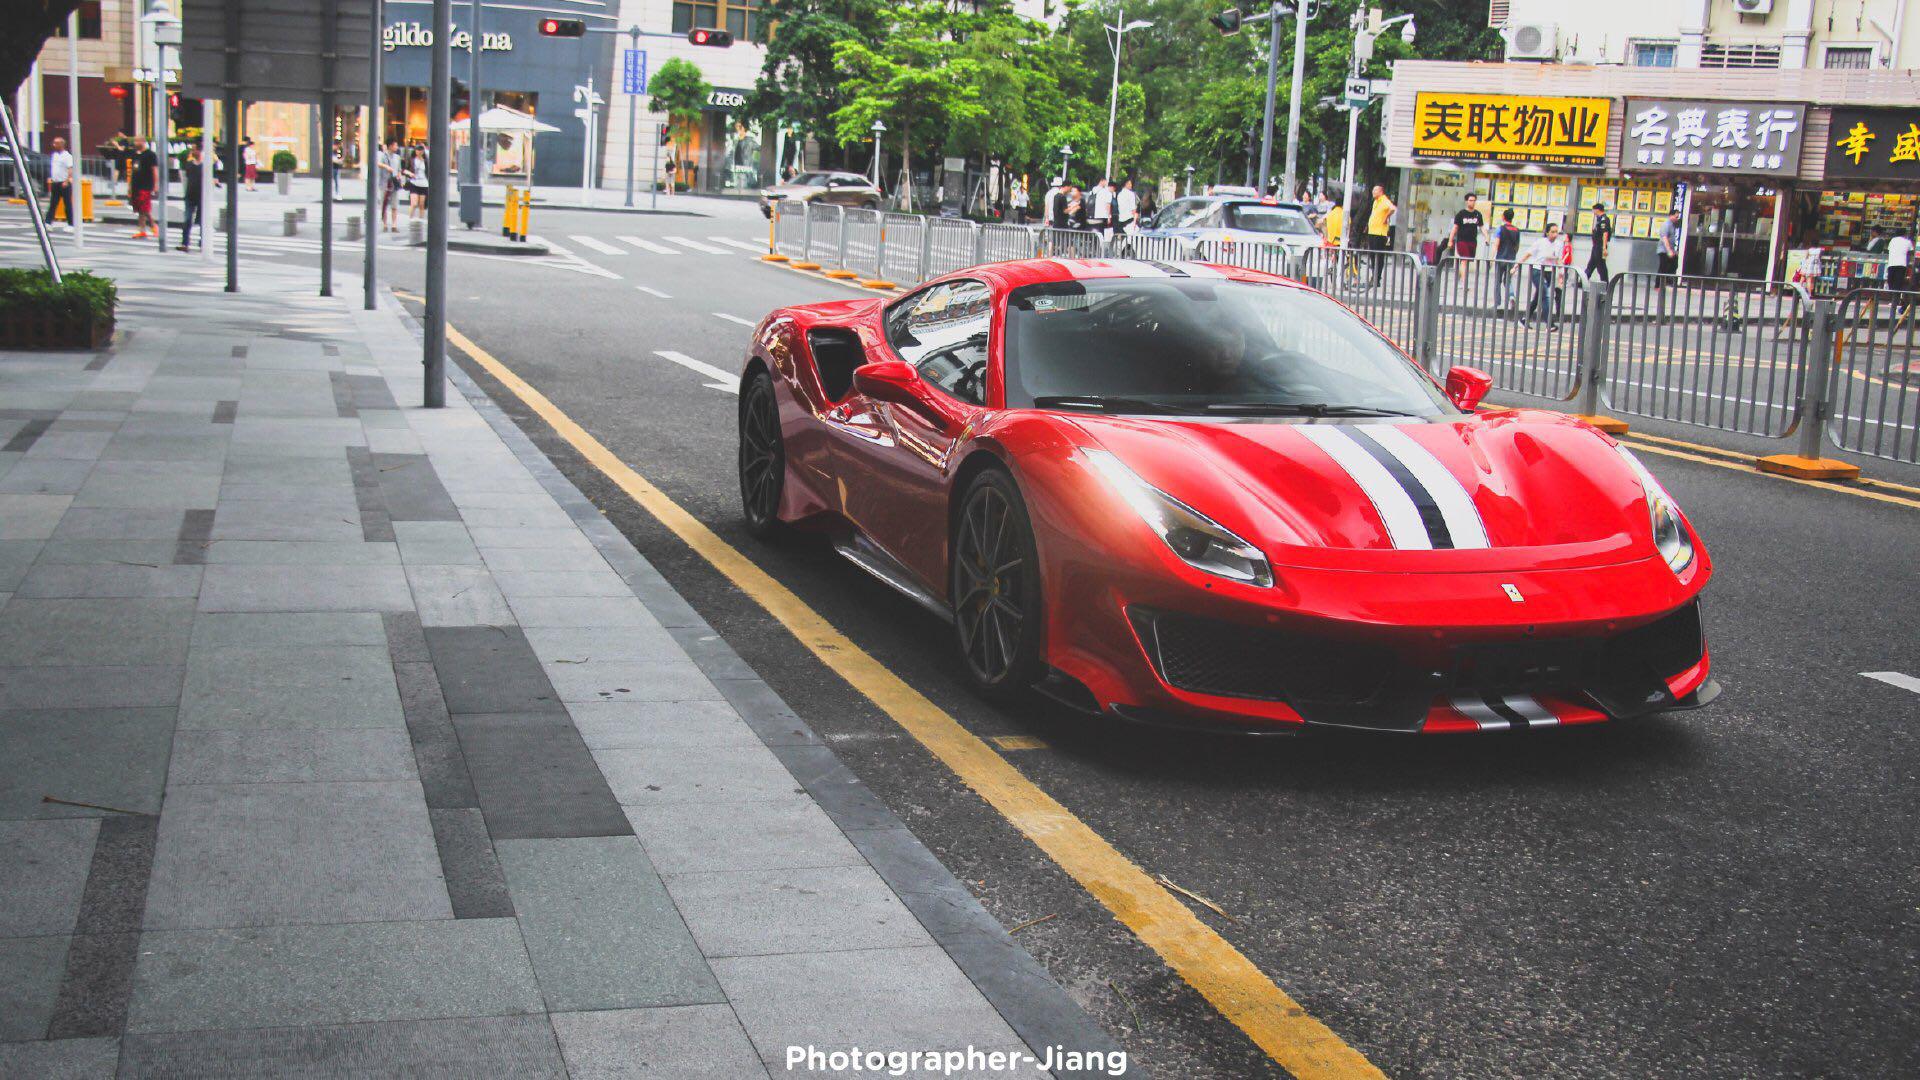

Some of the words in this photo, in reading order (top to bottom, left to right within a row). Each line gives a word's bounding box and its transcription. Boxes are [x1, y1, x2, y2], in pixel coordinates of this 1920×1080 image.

[1422, 101, 1600, 148] 美联物业
[1630, 105, 1798, 152] 名典表行
